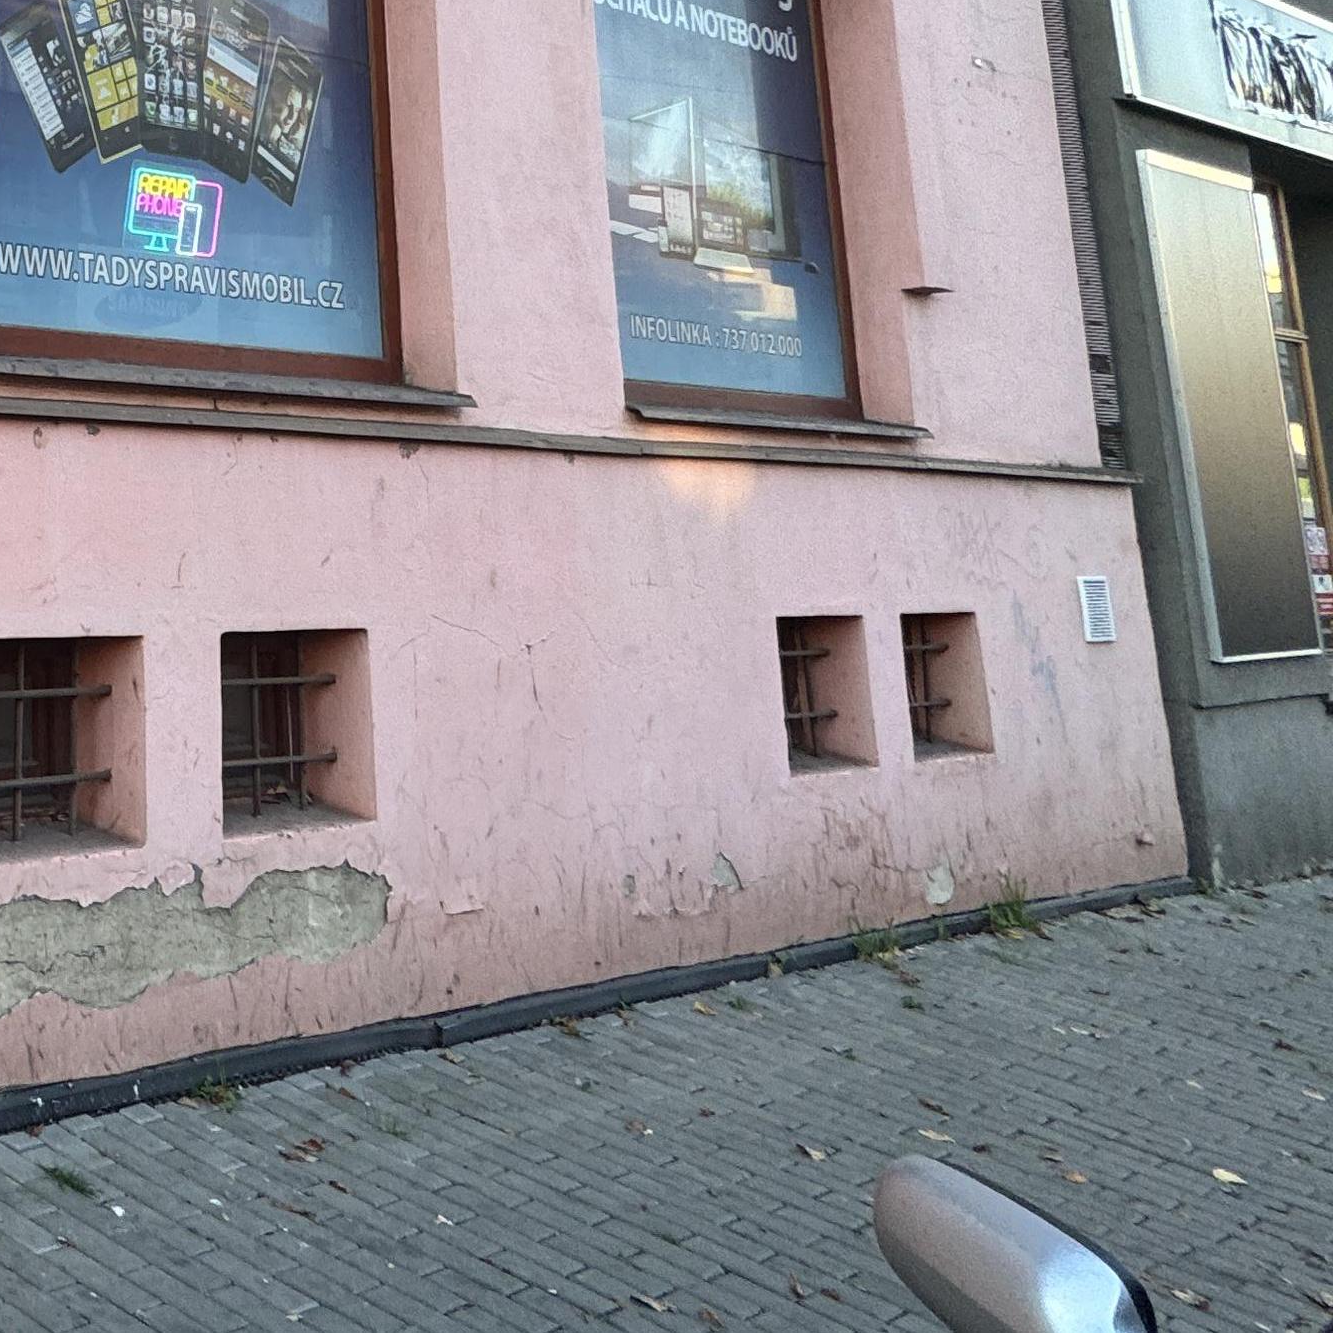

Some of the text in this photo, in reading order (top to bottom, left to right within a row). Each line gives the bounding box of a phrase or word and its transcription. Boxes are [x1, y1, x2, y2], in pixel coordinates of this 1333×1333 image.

[675, 0, 690, 31] A
[689, 3, 798, 62] NOTEBOOKŮ
[138, 173, 192, 200] REPAIR
[135, 193, 183, 218] PHONE
[630, 315, 712, 347] INFOLINKA
